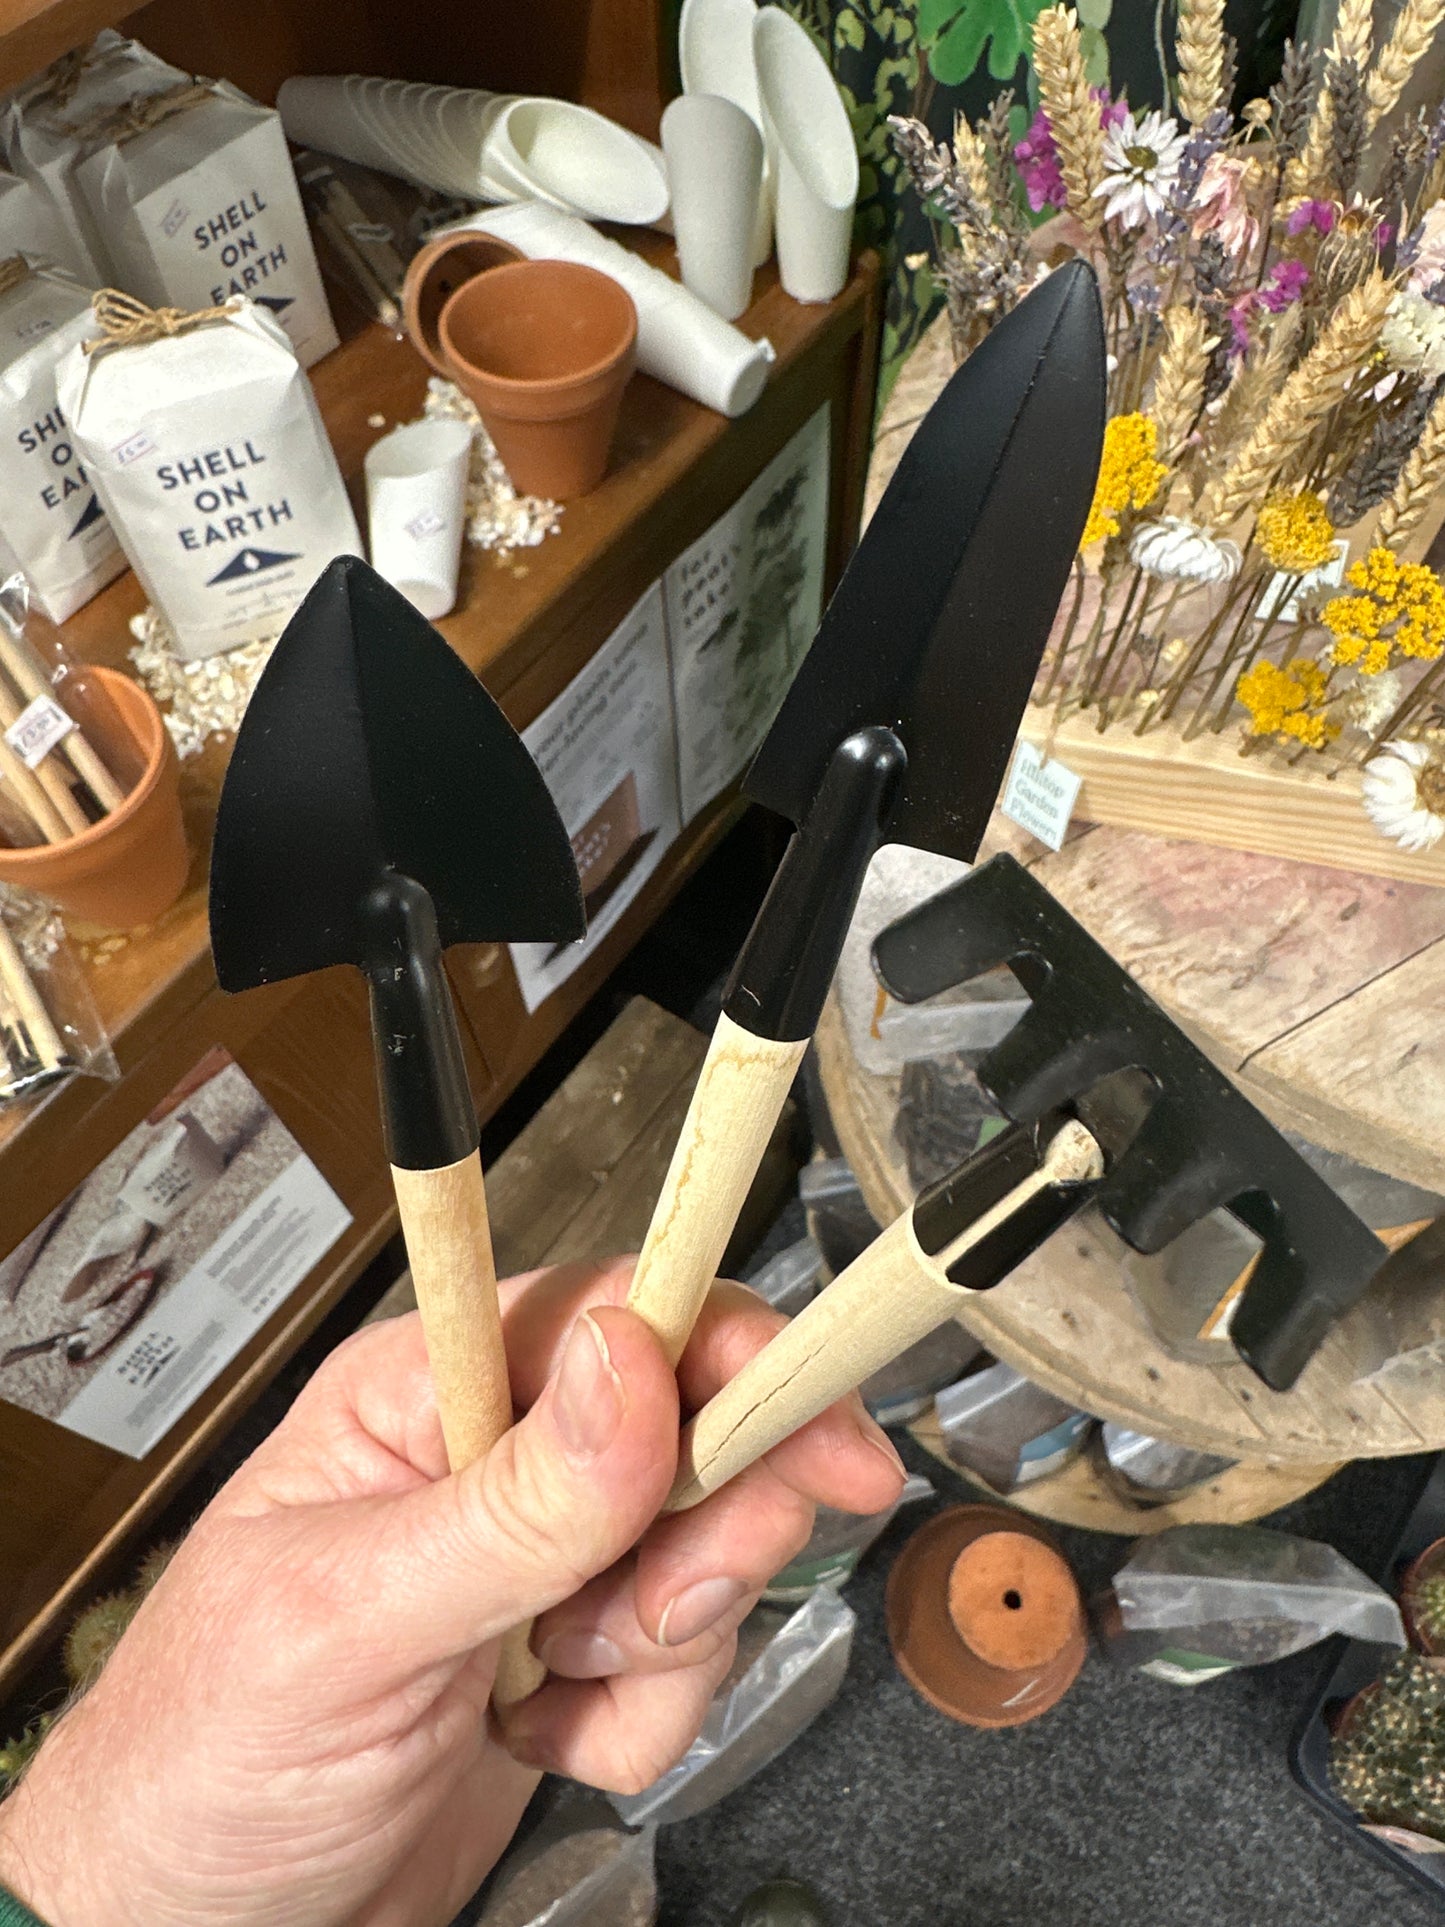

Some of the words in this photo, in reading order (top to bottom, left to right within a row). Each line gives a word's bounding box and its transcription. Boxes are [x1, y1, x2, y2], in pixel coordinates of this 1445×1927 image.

[194, 190, 267, 250] SHELL
[221, 230, 258, 268] ON
[210, 243, 288, 306] EARTH
[51, 442, 74, 466] O
[157, 441, 266, 491] SHELL
[194, 479, 249, 514] ON
[178, 499, 294, 551] EARTH
